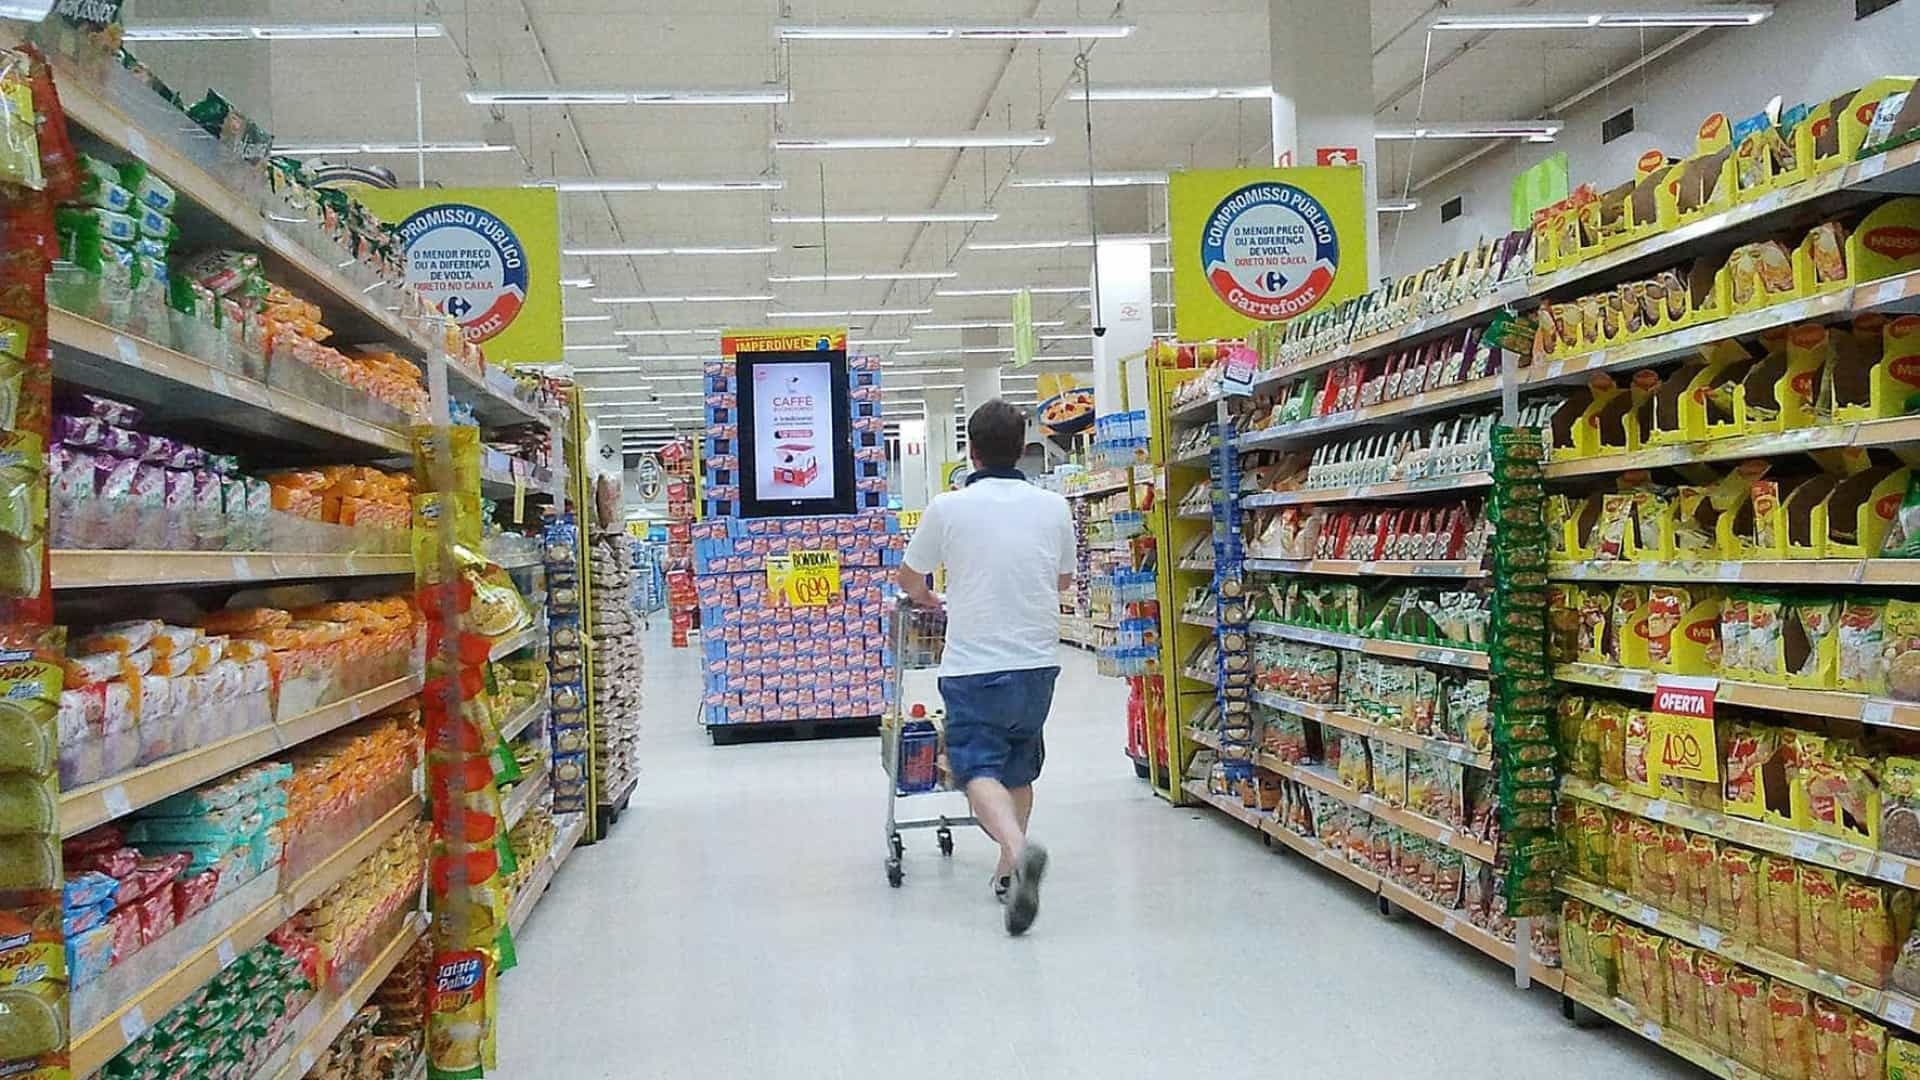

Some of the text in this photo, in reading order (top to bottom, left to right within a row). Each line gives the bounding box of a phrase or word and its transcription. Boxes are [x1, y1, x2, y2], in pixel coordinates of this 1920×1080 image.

[1208, 187, 1332, 246] COMPROMISSO PÚBLICO
[1234, 225, 1305, 236] O MENOR PREÇO
[400, 209, 521, 269] PROMISSO PÚBLICO
[1235, 236, 1304, 246] OU A DIFERENÇA
[414, 249, 491, 260] O MENOR PREÇO
[1250, 247, 1261, 256] DE
[415, 259, 490, 271] OU A DIFERENÇA
[1235, 255, 1307, 266] DIRETO NO CAIXA
[430, 271, 442, 280] DE
[448, 282, 462, 290] NO
[464, 282, 493, 291] CAIXA
[1228, 286, 1316, 316] Carrefour
[735, 337, 806, 352] IMPERDÍVEL
[1660, 693, 1705, 714] OFERTA
